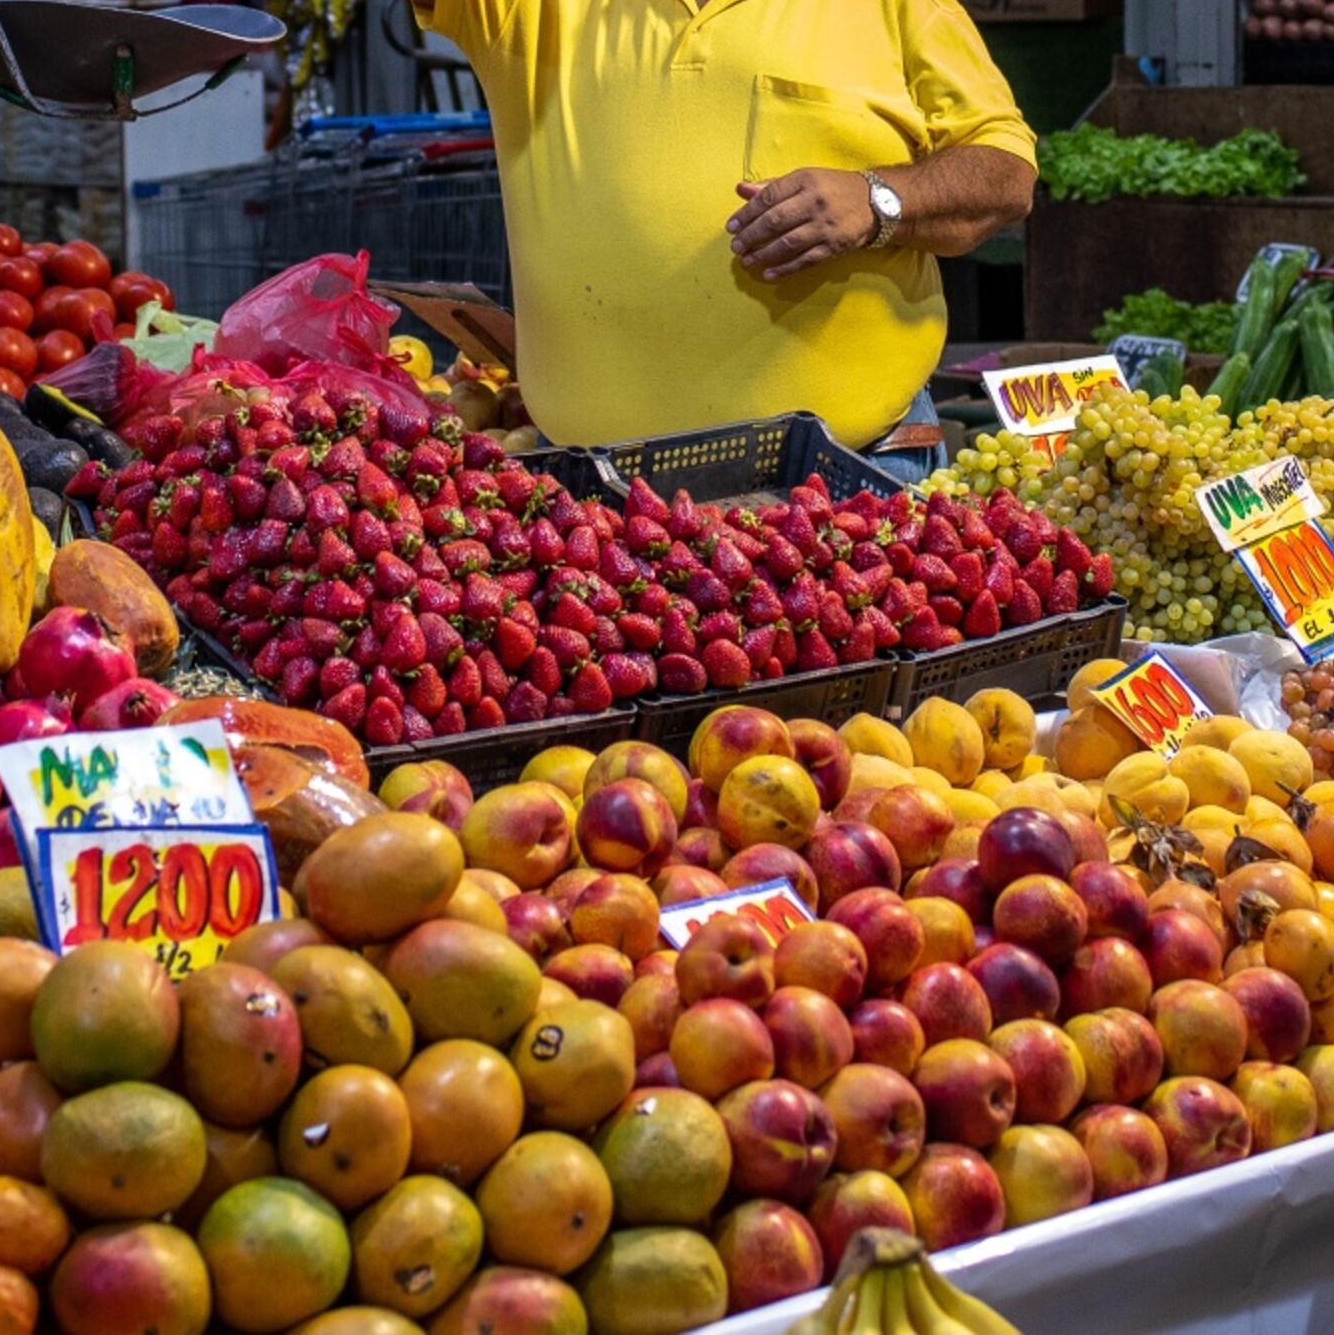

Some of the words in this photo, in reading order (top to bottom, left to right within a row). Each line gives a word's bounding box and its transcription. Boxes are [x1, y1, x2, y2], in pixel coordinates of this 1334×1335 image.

[997, 371, 1074, 425] UVA
[1204, 474, 1265, 531] UVA
[62, 842, 264, 947] 1200
